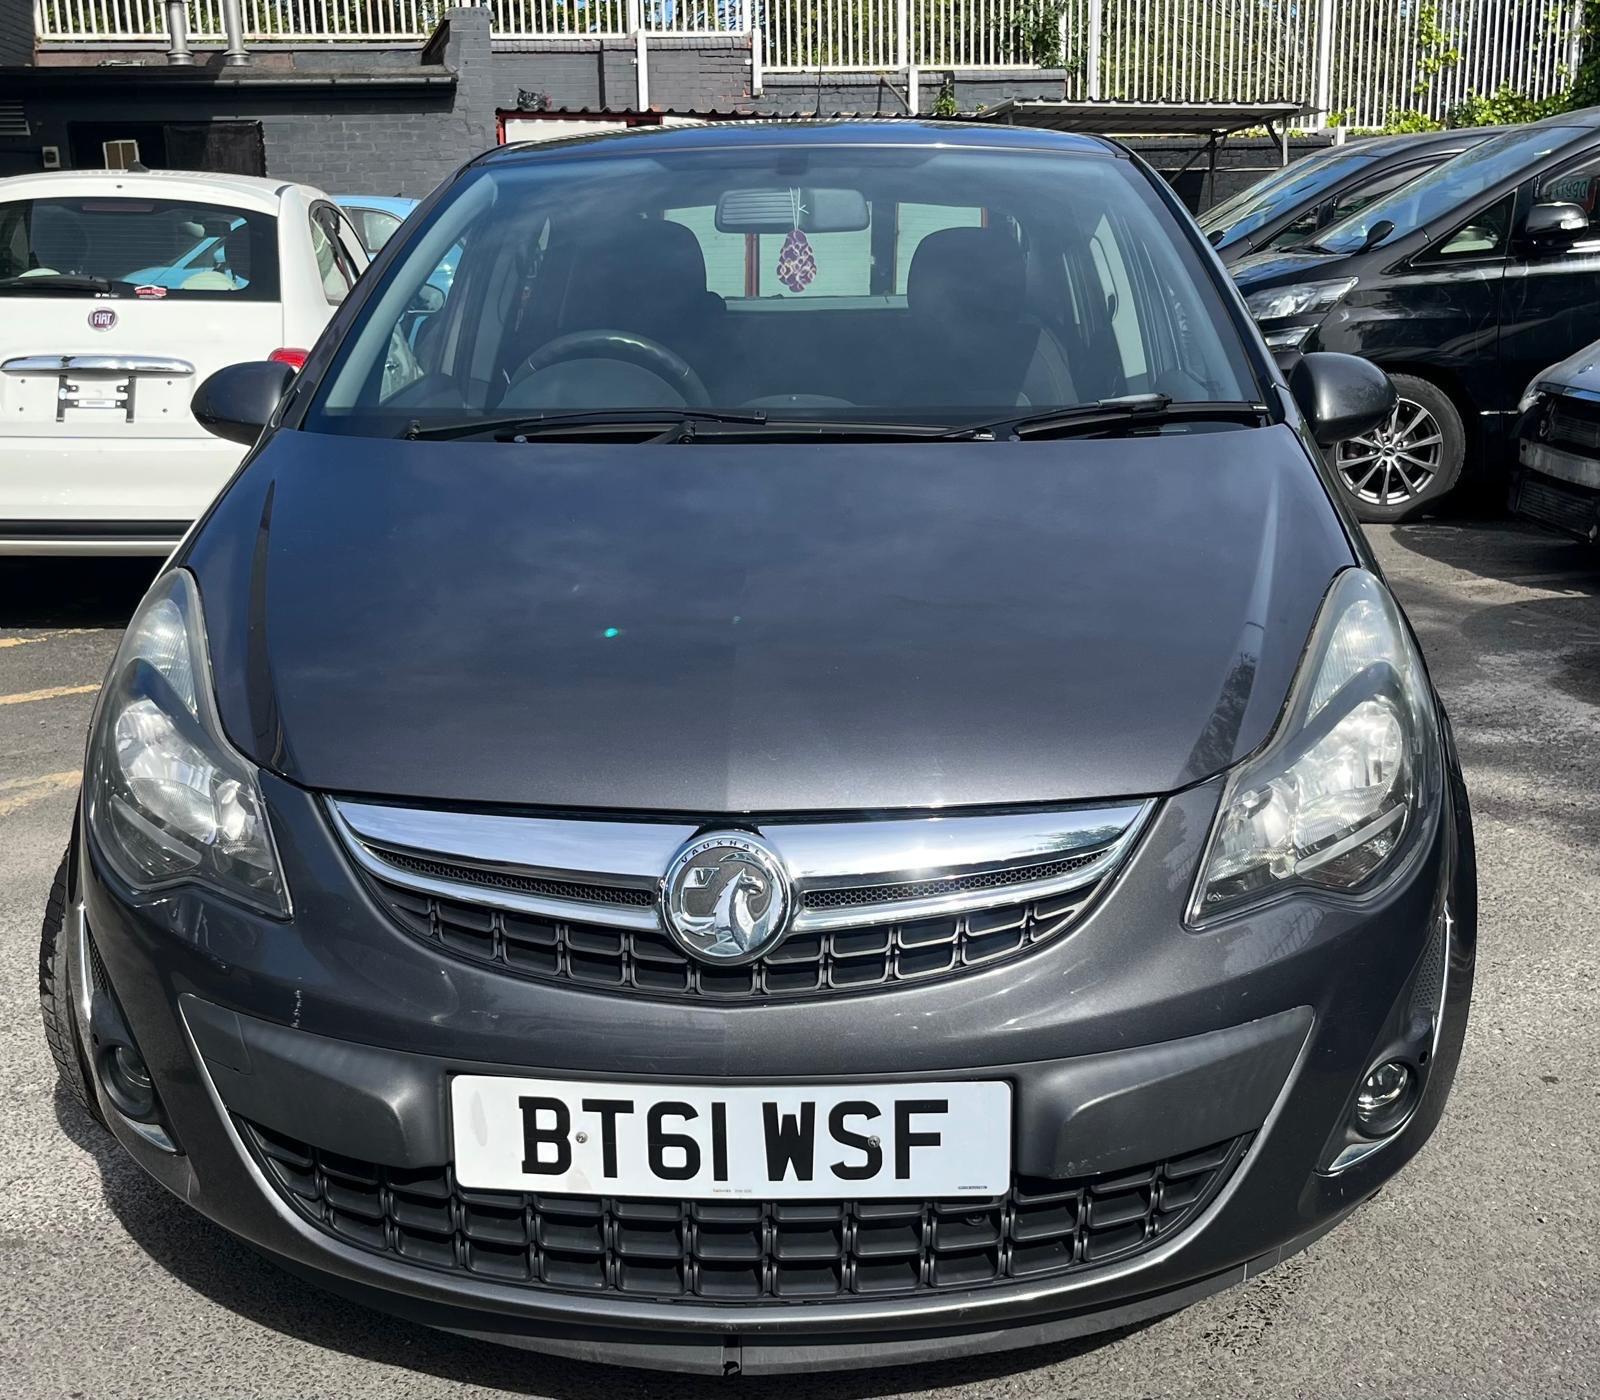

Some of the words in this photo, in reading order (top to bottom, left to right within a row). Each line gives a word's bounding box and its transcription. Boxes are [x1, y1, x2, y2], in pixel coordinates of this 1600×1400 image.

[94, 312, 113, 325] FIAT
[518, 1096, 728, 1182] BT61
[762, 1099, 948, 1182] WSF
